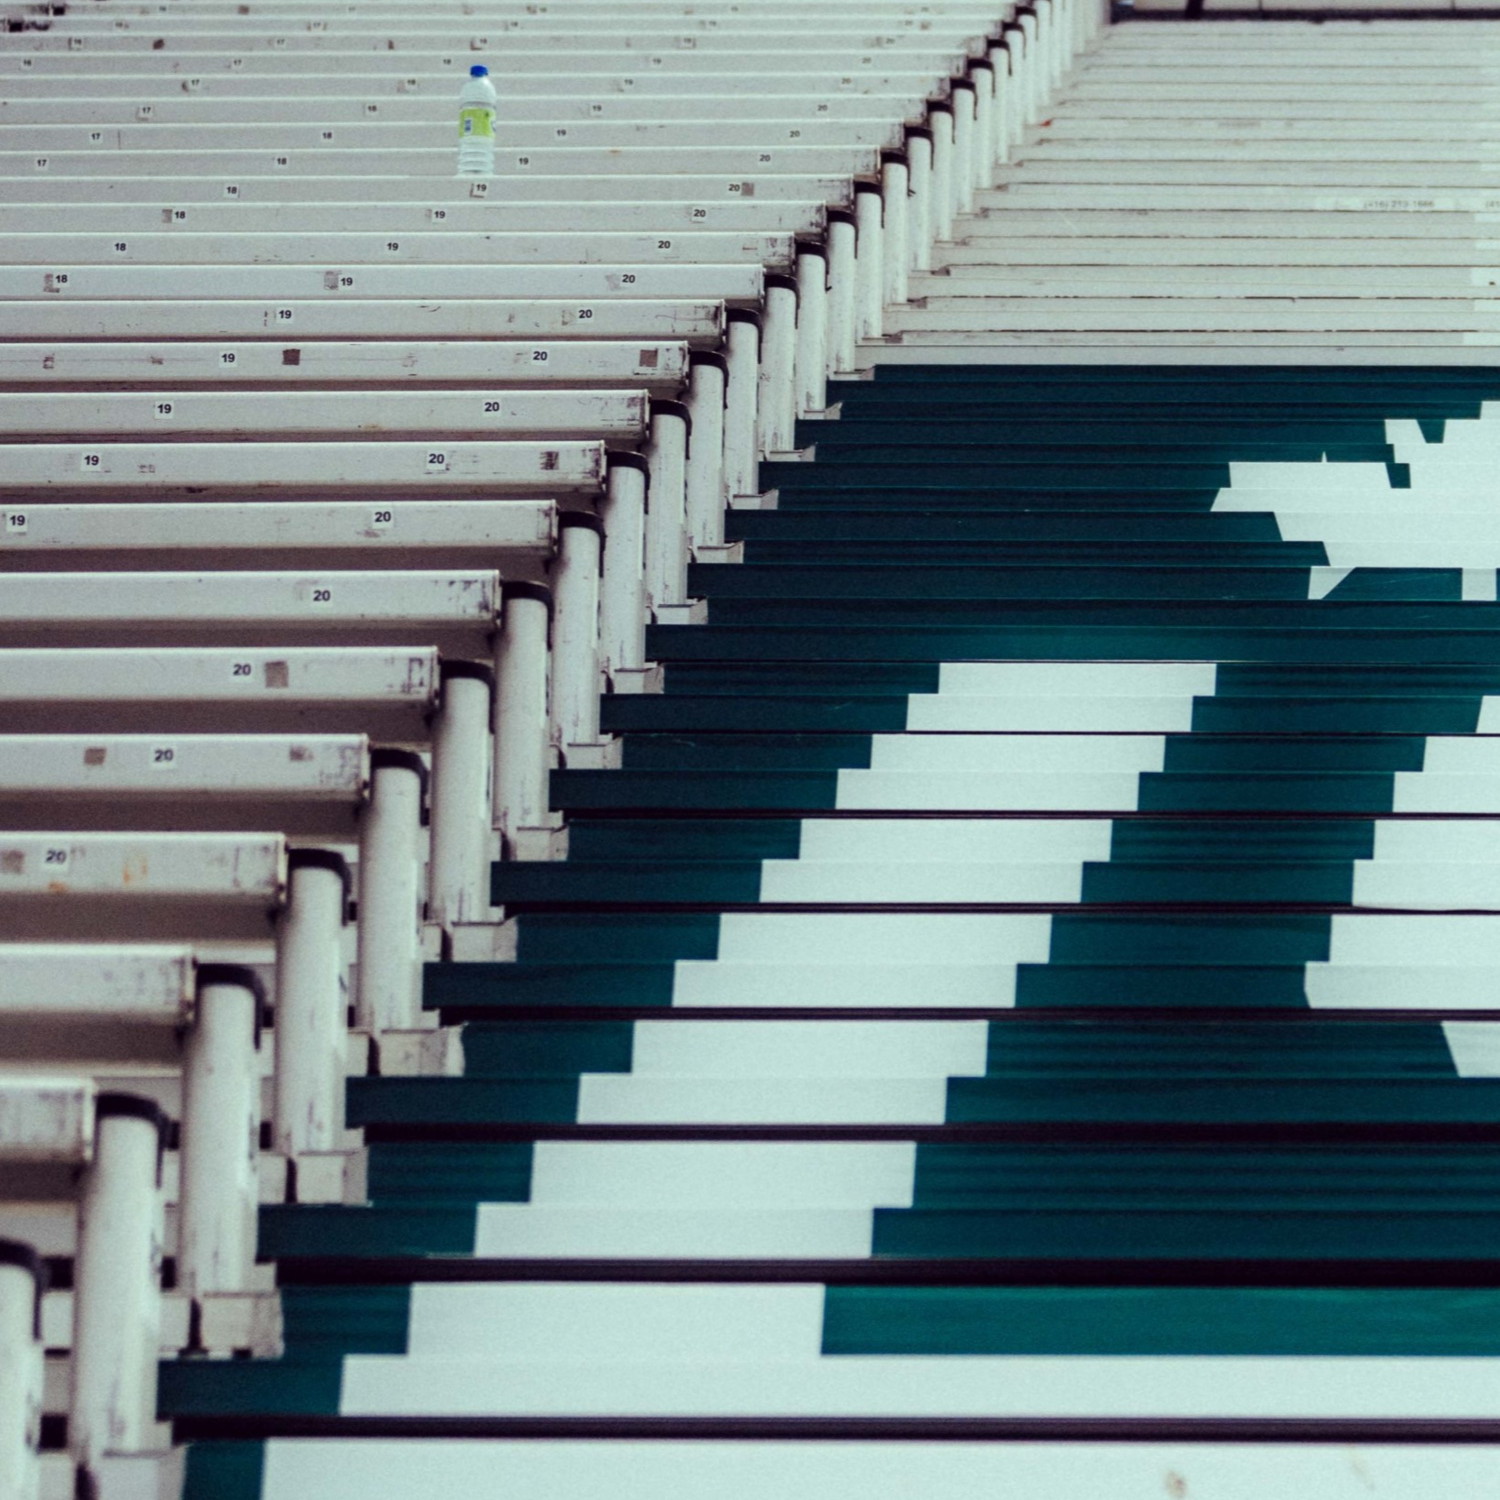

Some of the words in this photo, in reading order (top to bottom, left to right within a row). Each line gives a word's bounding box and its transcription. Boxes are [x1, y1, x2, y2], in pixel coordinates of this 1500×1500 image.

[37, 158, 47, 167] 17
[276, 157, 287, 166] 18
[518, 157, 529, 165] 19
[759, 154, 772, 163] 20
[226, 186, 238, 195] 18
[476, 183, 487, 192] 19
[728, 183, 741, 192] 20
[174, 210, 186, 220] 18
[434, 210, 446, 219] 19
[693, 208, 707, 218] 20
[114, 242, 127, 252] 18
[387, 242, 399, 251] 19
[657, 240, 671, 249] 20
[55, 274, 68, 284] 18
[340, 277, 354, 286] 19
[621, 273, 636, 284] 20
[278, 309, 292, 320] 19
[578, 309, 593, 319] 20
[221, 352, 236, 363] 19
[532, 350, 548, 361] 20
[157, 403, 172, 414] 19
[484, 401, 500, 413] 20
[84, 454, 100, 466] 19
[428, 453, 445, 465] 20
[9, 514, 26, 526] 19
[374, 510, 392, 523] 20
[313, 589, 331, 602] 20
[232, 663, 252, 676] 20
[154, 748, 174, 763] 20
[45, 849, 67, 863] 20
